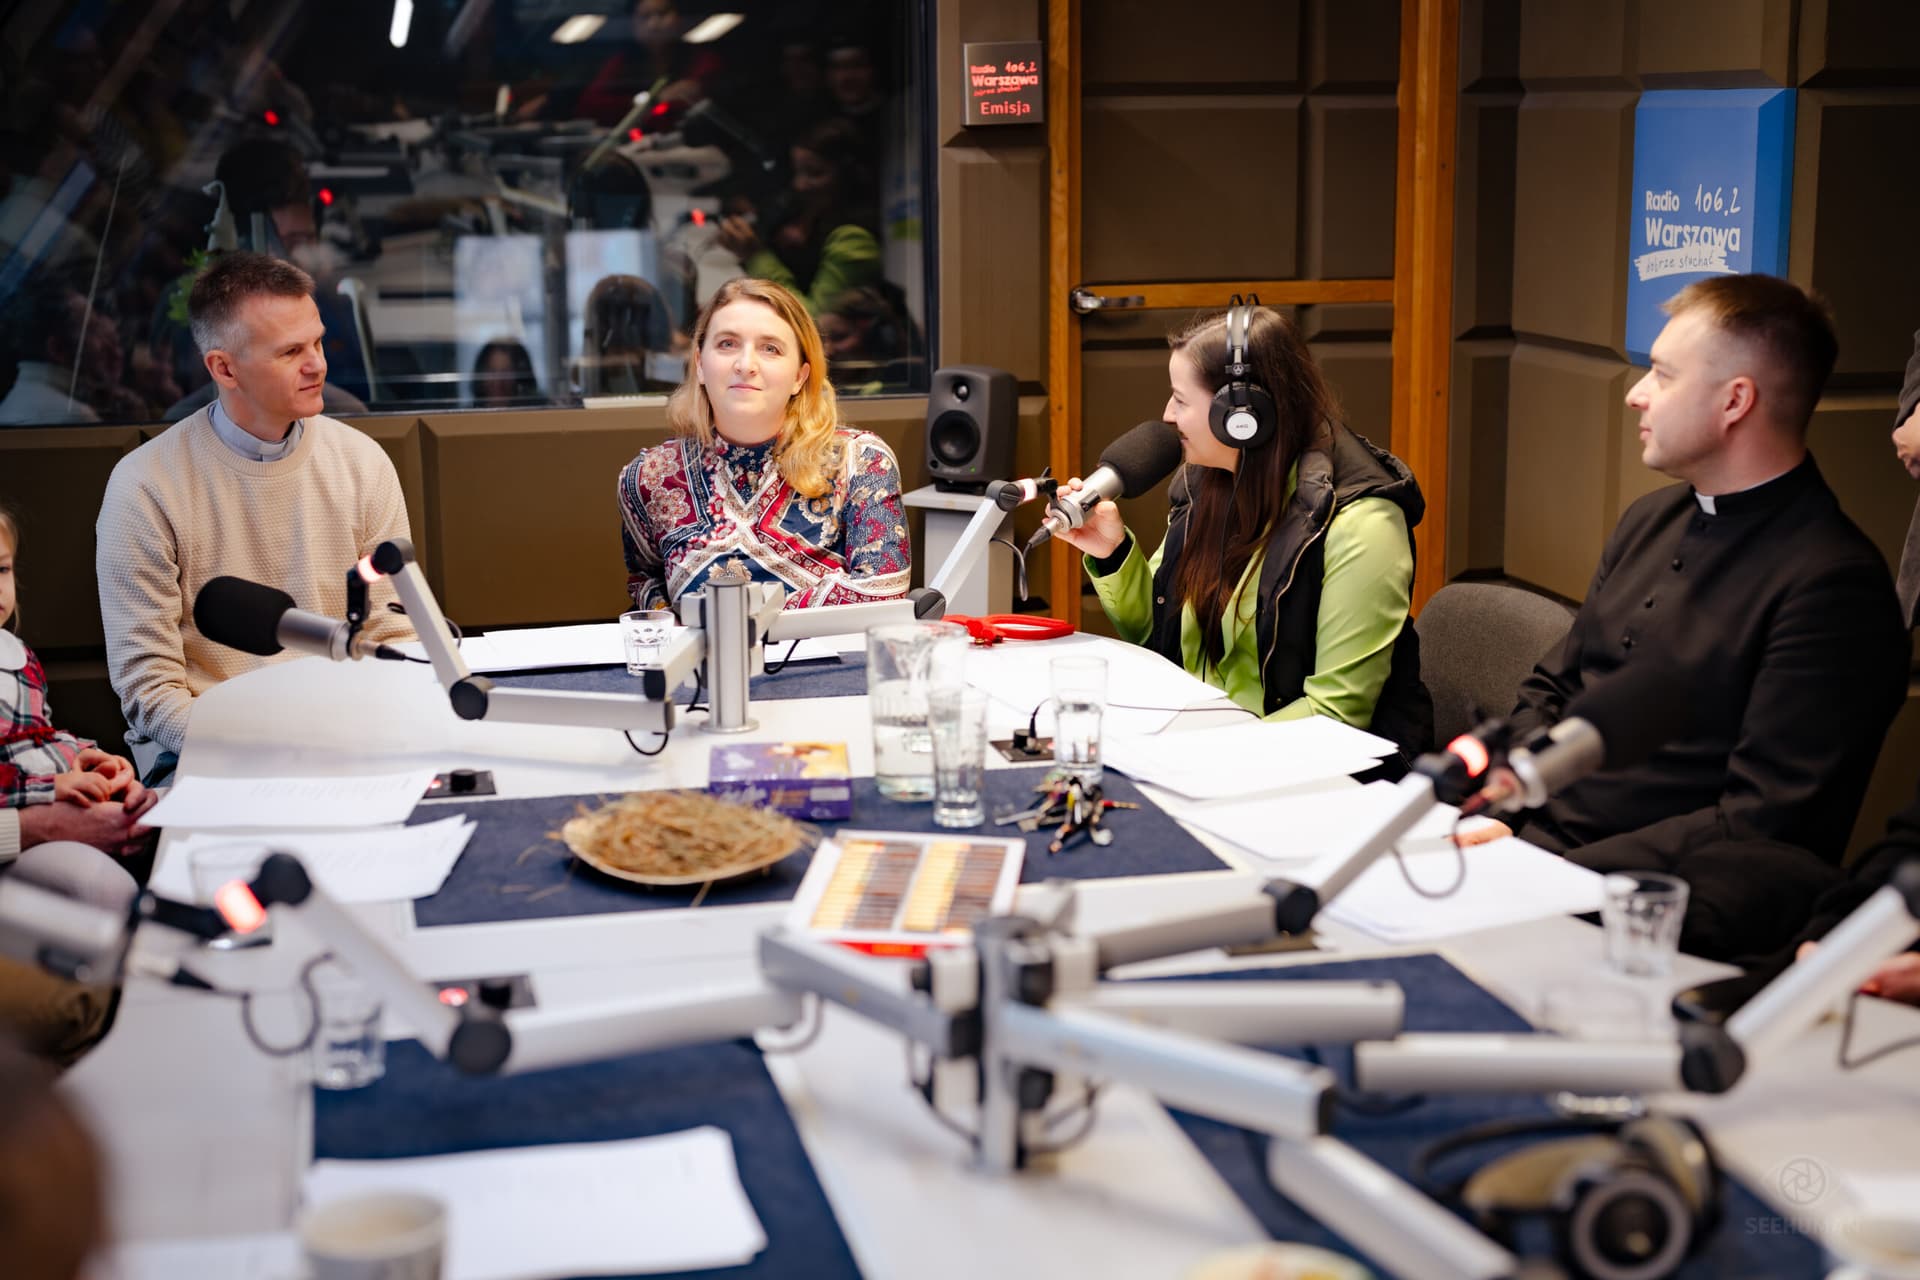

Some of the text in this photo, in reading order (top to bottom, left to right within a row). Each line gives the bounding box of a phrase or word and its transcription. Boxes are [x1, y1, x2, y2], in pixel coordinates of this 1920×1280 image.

[971, 75, 1038, 87] Warszawa
[980, 101, 1031, 116] Emisja
[1645, 190, 1680, 212] Radio
[1645, 217, 1741, 252] Warszawa
